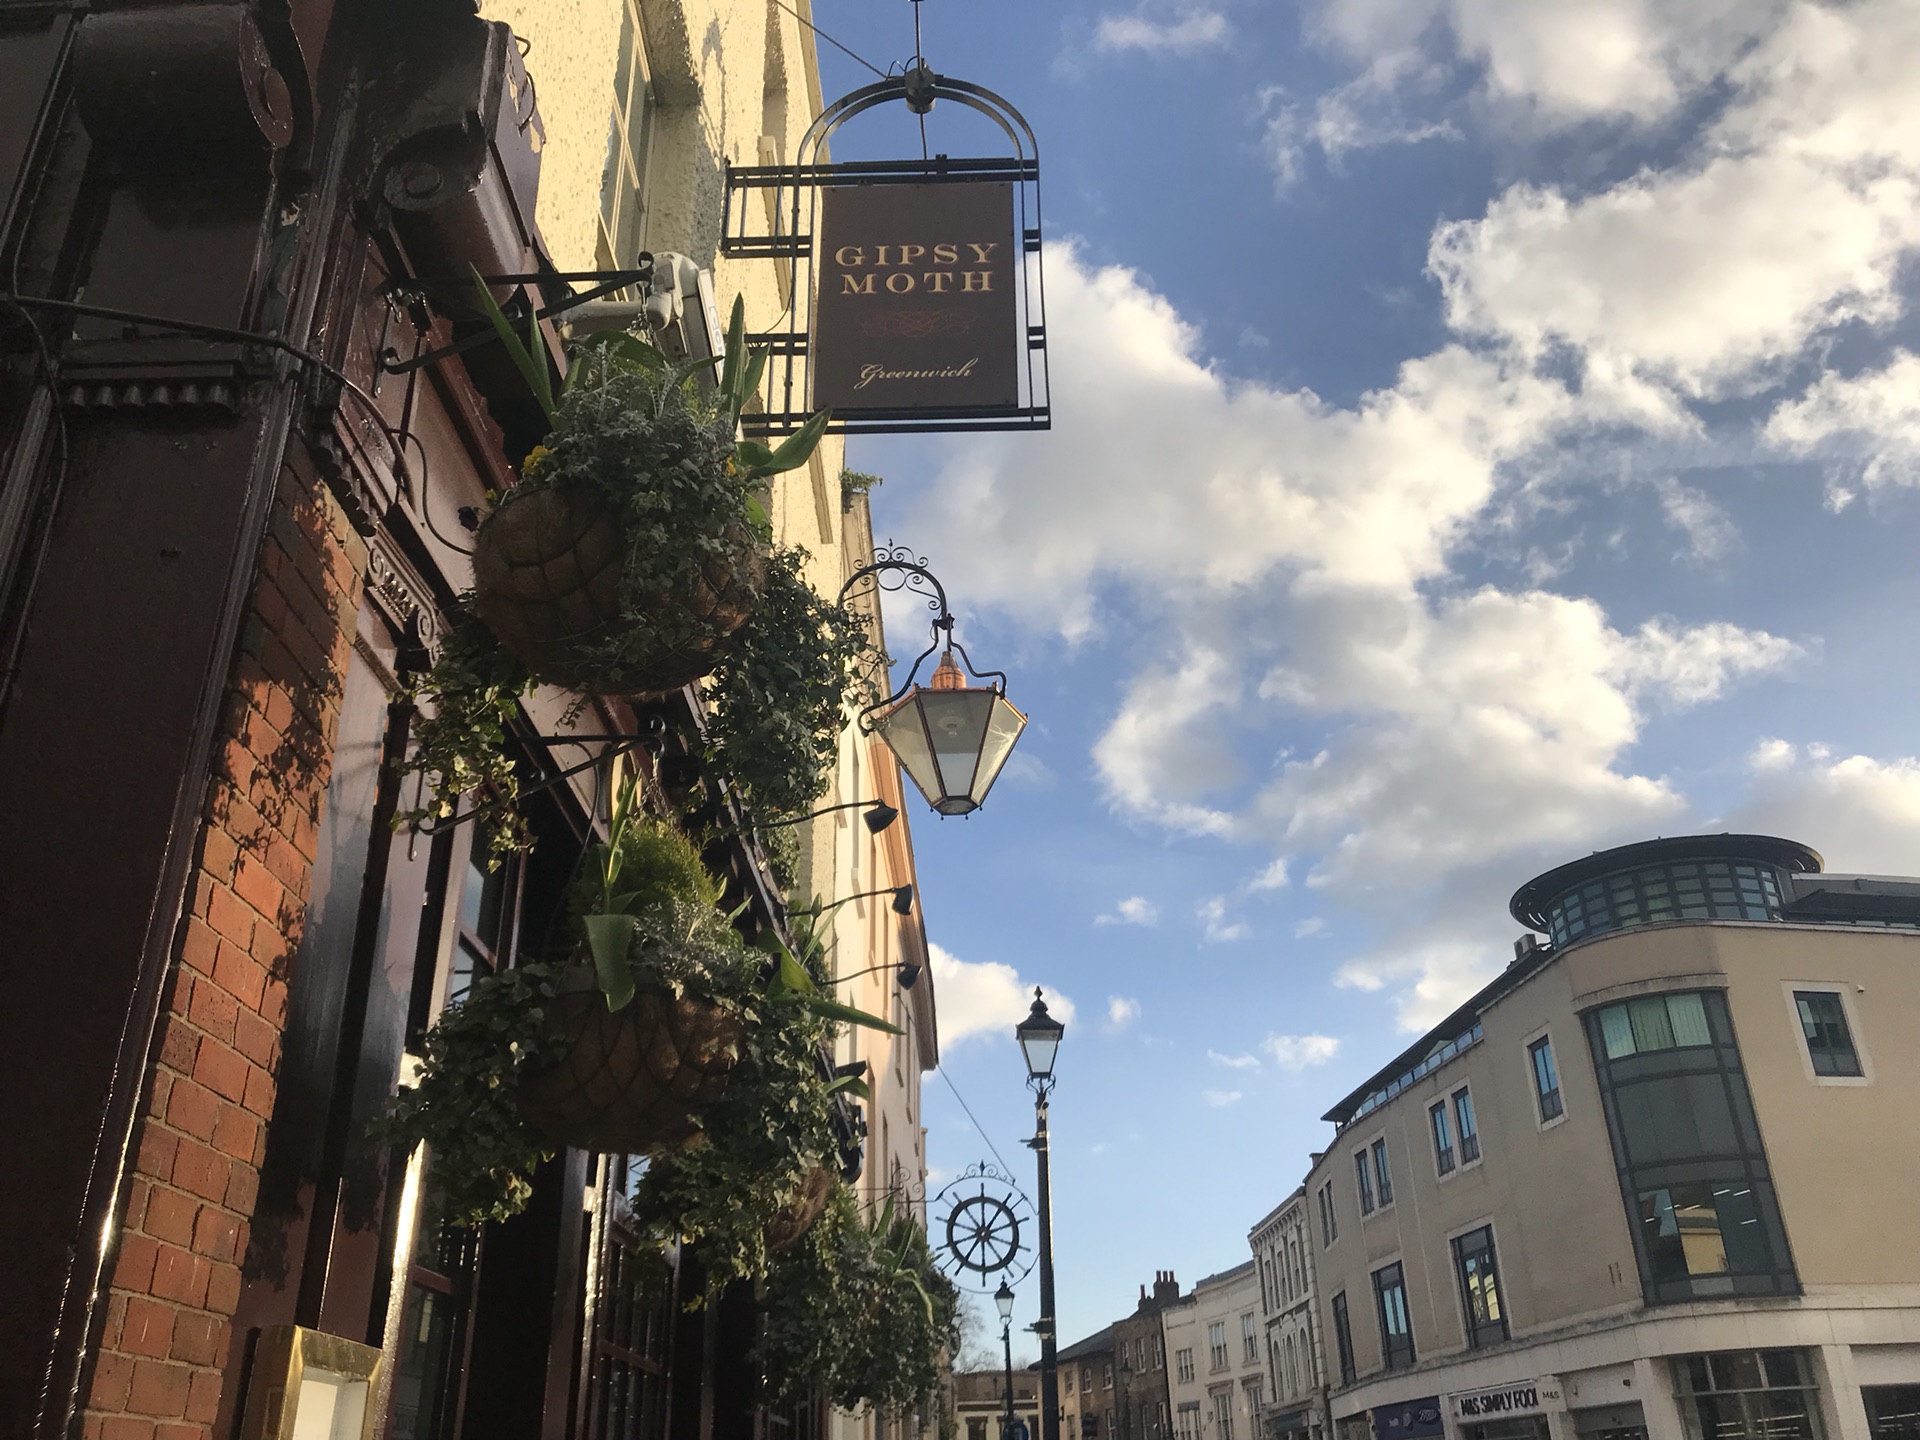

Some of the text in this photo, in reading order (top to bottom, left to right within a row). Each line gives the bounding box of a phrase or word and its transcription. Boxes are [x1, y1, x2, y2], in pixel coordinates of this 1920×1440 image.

[834, 242, 998, 267] GIPSY
[840, 270, 994, 295] MOTH
[853, 357, 979, 390] Greenwich
[1480, 1391, 1513, 1414] SIMPLY
[1542, 1391, 1560, 1399] M&S
